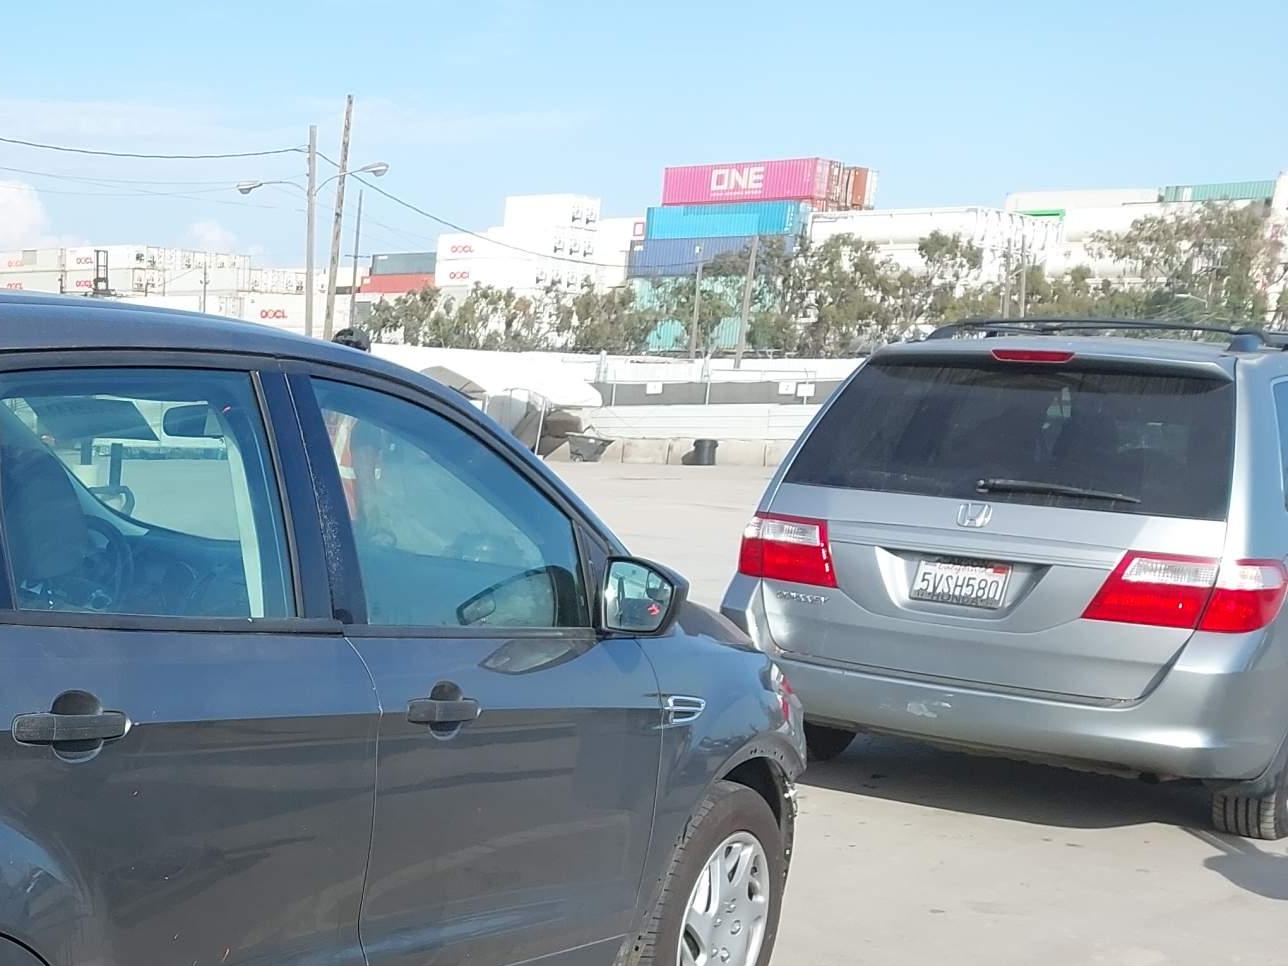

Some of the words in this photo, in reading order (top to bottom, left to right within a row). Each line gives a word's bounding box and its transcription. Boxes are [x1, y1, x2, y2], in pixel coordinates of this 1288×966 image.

[711, 166, 764, 191] ONE
[260, 309, 287, 319] OOCL
[921, 571, 1000, 600] 5VSH580
